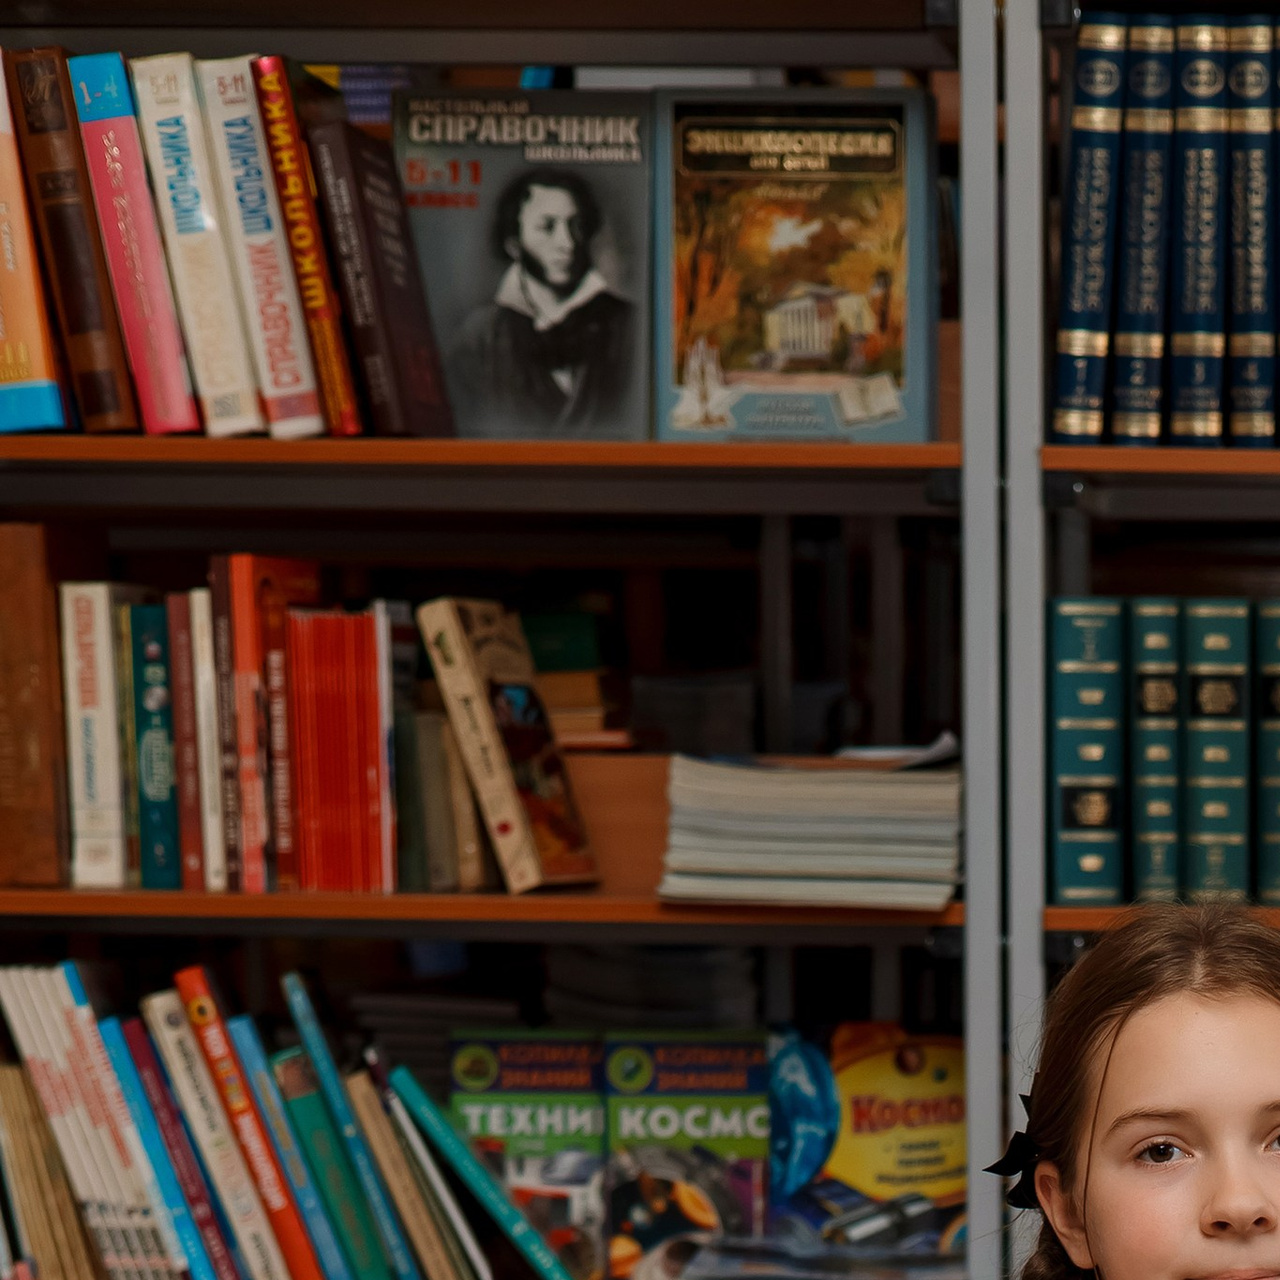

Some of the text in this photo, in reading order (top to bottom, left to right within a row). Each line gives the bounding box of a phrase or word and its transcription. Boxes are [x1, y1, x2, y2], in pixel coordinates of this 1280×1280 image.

[408, 114, 641, 144] СПРАВОЧНИК
[155, 114, 206, 235] ШКОЛЬНИКА
[259, 71, 326, 310] ШКОЛЬНИКА
[223, 114, 303, 390] СПРАВОЧНИК ШКОЛЬНИКА
[1074, 361, 1089, 386] 1
[1129, 360, 1147, 386] 2
